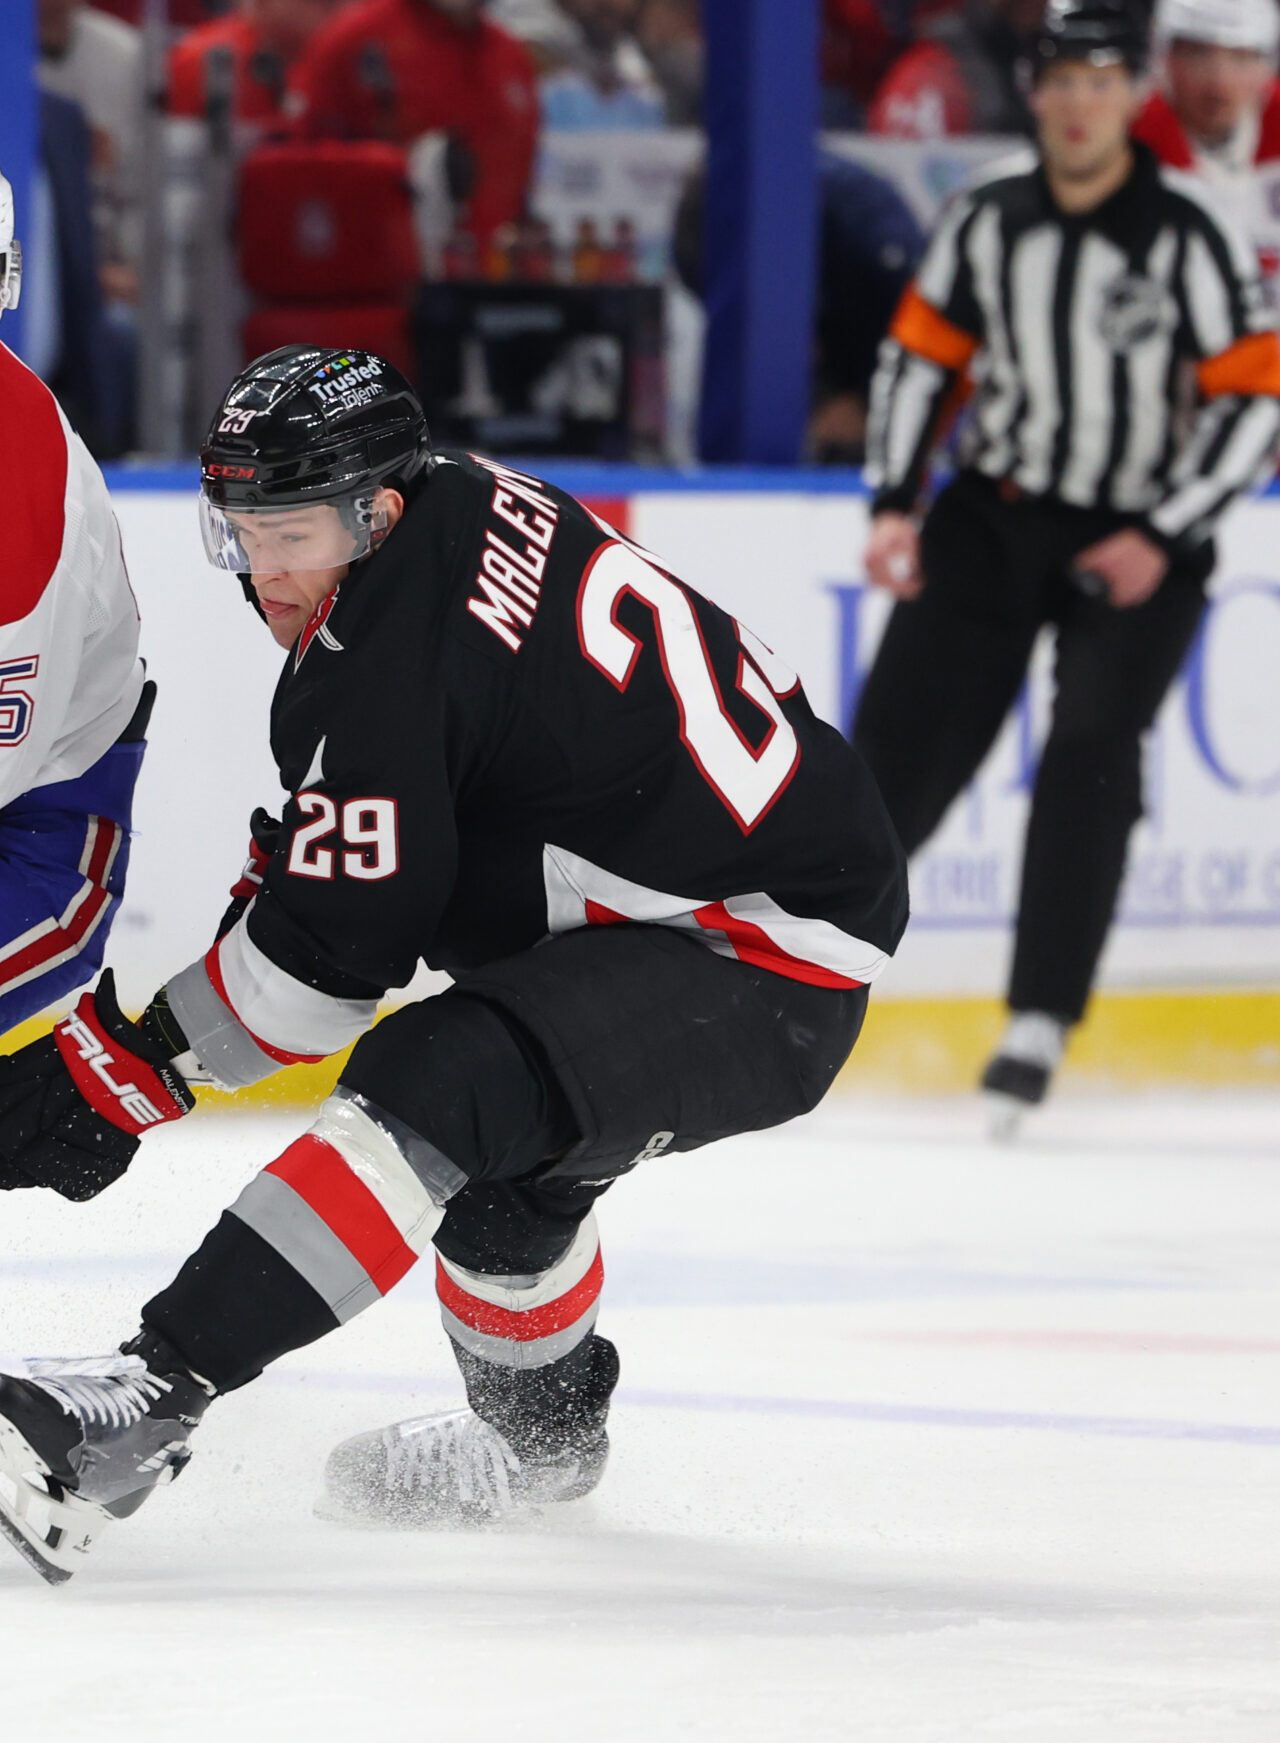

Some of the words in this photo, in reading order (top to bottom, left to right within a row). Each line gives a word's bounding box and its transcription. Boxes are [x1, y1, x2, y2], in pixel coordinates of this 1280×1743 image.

[308, 356, 383, 402] Trusted
[218, 408, 257, 434] 29
[208, 463, 258, 480] CCM
[572, 496, 803, 837] 2
[286, 791, 400, 882] 29
[56, 1010, 165, 1126] TRUE
